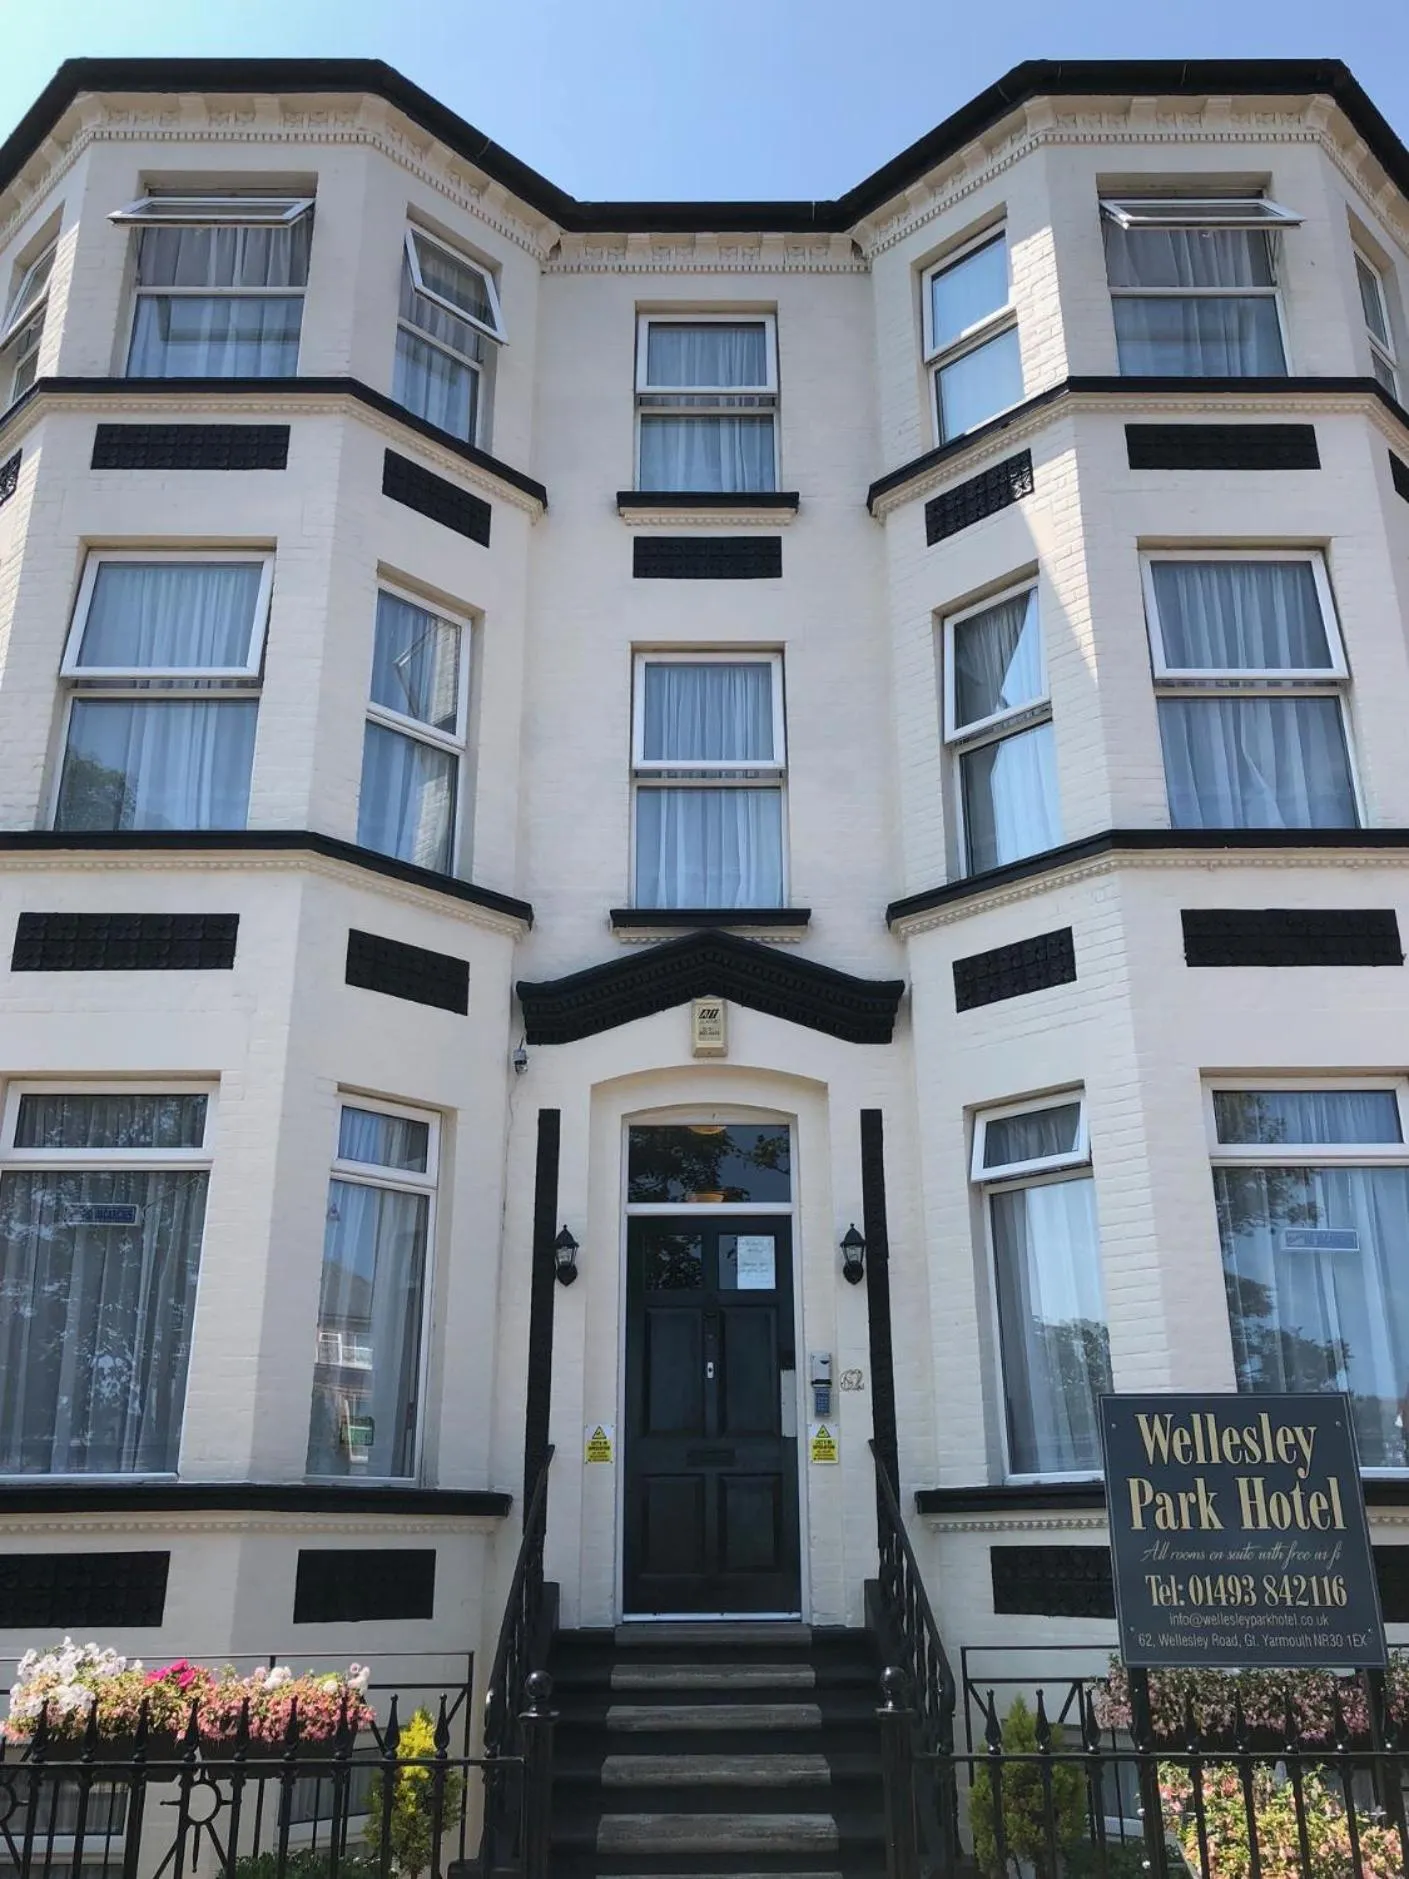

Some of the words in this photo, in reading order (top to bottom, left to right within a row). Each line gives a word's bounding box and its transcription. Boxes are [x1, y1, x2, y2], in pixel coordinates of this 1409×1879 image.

[840, 1368, 865, 1391] 62
[1134, 1412, 1317, 1479] Wellesley
[1126, 1477, 1225, 1531] Park
[1234, 1476, 1348, 1531] Hotel
[1140, 1540, 1170, 1562] All
[1170, 1551, 1206, 1561] rooms
[1227, 1541, 1261, 1561] suite
[1258, 1541, 1290, 1561] with
[1281, 1540, 1312, 1571] free
[1144, 1574, 1186, 1607] Tel:
[1188, 1574, 1258, 1607] 01493
[1262, 1574, 1348, 1607] 842116
[1169, 1612, 1330, 1629] info@wellesleyparkhotel.co.uk
[1138, 1633, 1156, 1648] 62,
[1158, 1633, 1209, 1652] Wellesley
[1211, 1632, 1242, 1648] Road,
[1261, 1633, 1313, 1648] Yarmouth
[1313, 1633, 1344, 1648] NR30
[1346, 1632, 1368, 1648] 1EX
